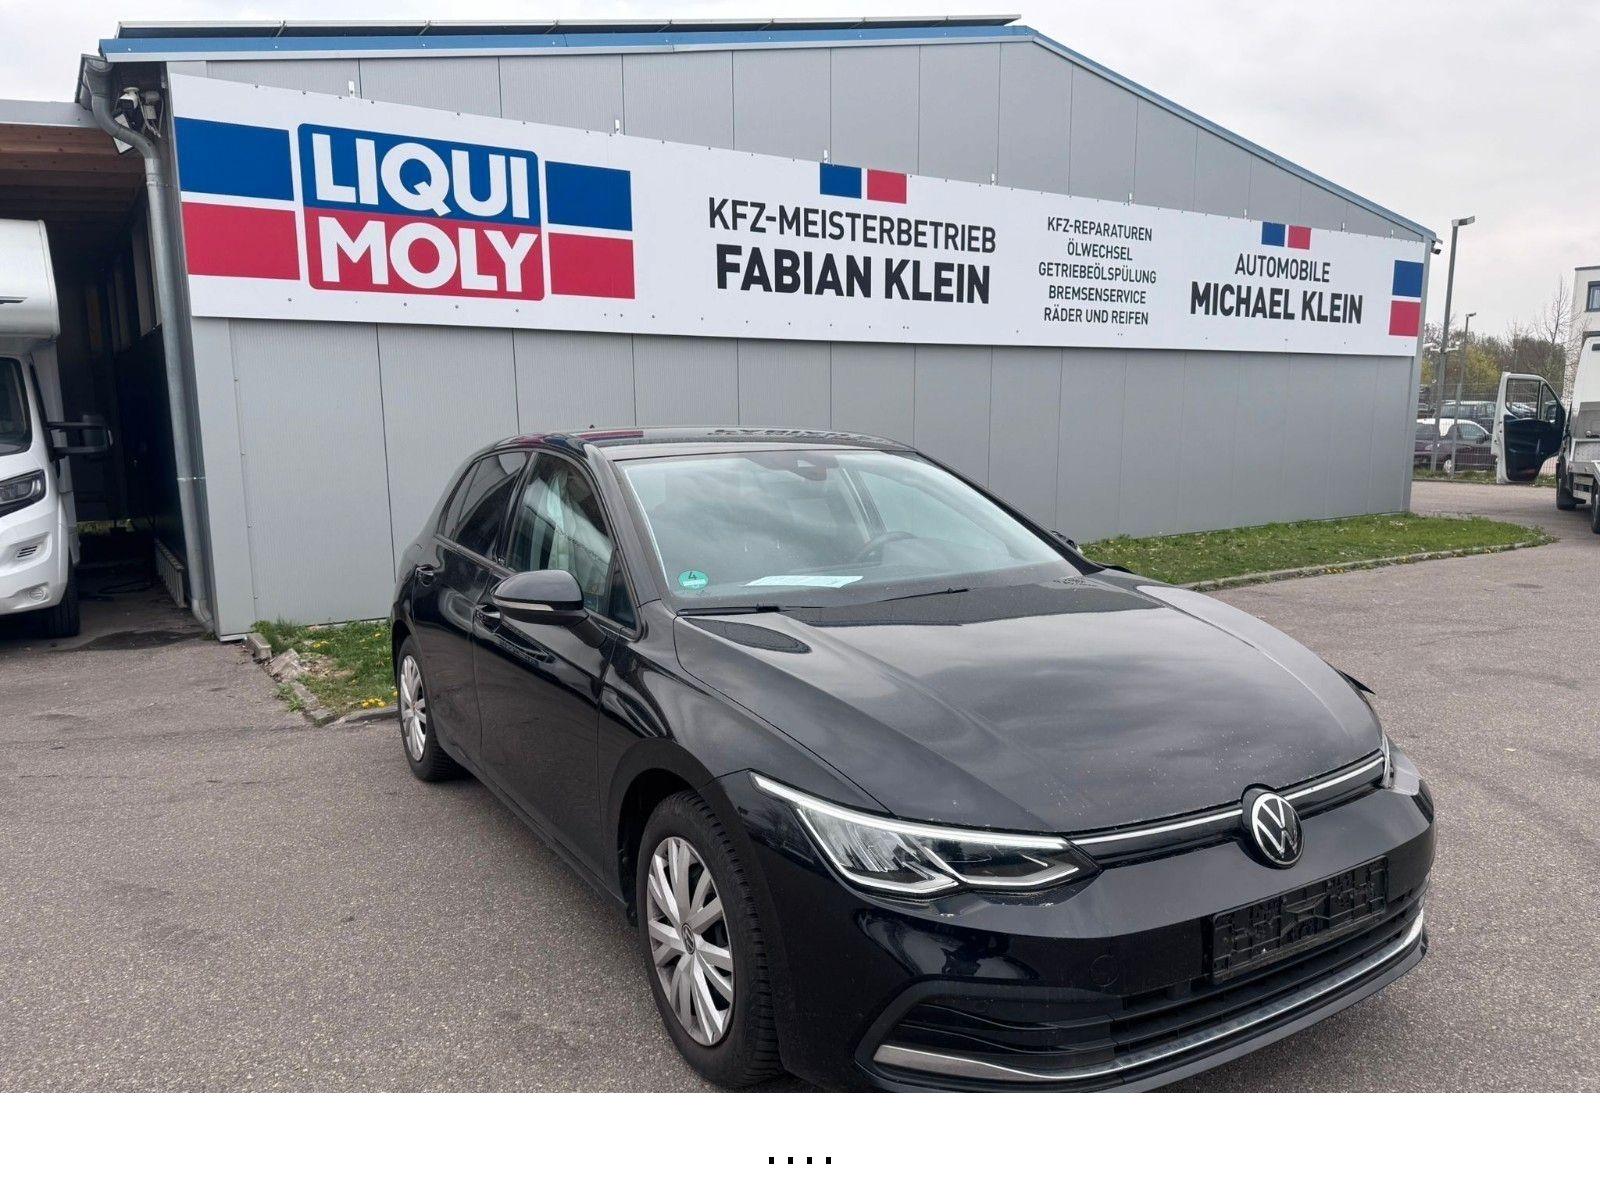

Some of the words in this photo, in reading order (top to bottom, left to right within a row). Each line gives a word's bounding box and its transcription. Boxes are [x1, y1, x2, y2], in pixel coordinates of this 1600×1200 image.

[312, 133, 530, 218] LIQUI
[708, 196, 996, 254] KFZ-MEISTERBETRIEB
[1047, 216, 1153, 242] KFZ-REPARATUREN
[318, 216, 538, 293] MOLY
[1066, 237, 1133, 261] ÖLWECHSEL
[716, 243, 872, 299] FABIAN
[884, 257, 990, 304] KLEIN
[1038, 260, 1157, 284] GETRIEBEÖLSPÜLUNG
[1234, 253, 1331, 283] AUTOMOBILE
[1048, 284, 1147, 305] BREMSENSERVICE
[1190, 280, 1296, 321] MICHAEL
[1301, 290, 1363, 325] KLEIN
[1043, 305, 1083, 323] RÄDER
[1085, 309, 1109, 324] UND
[1111, 310, 1149, 326] REIFEN
